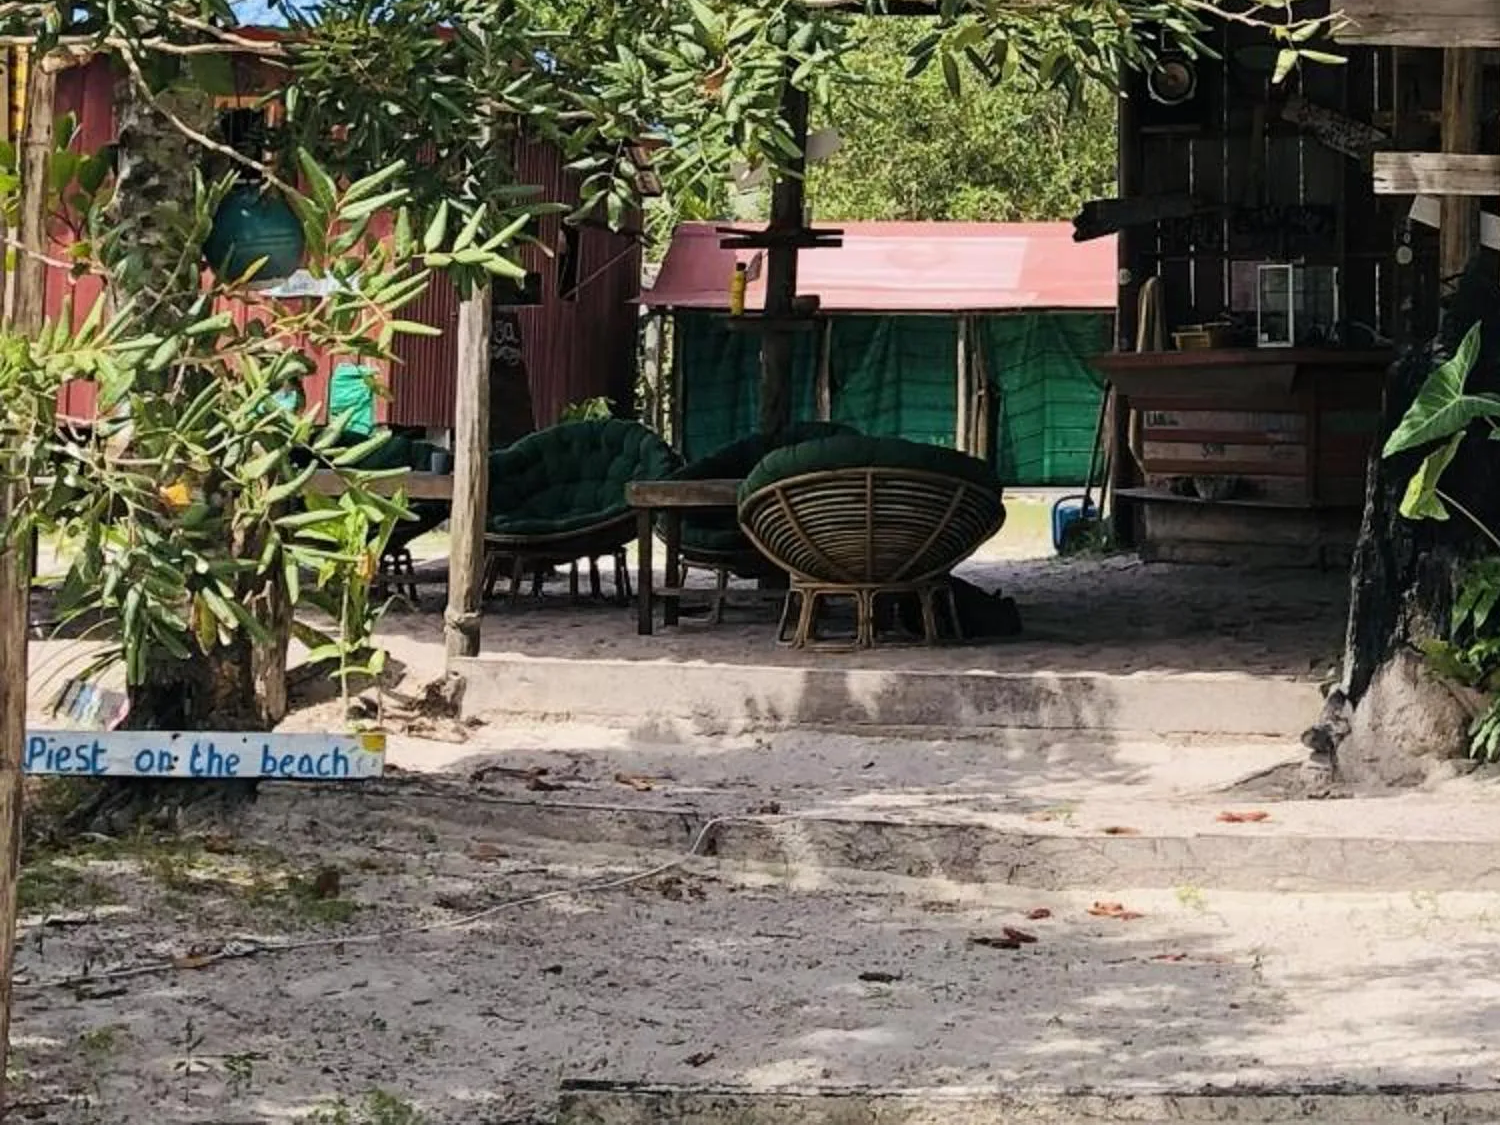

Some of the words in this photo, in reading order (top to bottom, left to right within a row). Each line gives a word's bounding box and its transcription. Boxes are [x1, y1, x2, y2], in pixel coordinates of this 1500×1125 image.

[134, 748, 174, 774] on
[189, 740, 241, 775] the
[260, 743, 350, 777] beach
